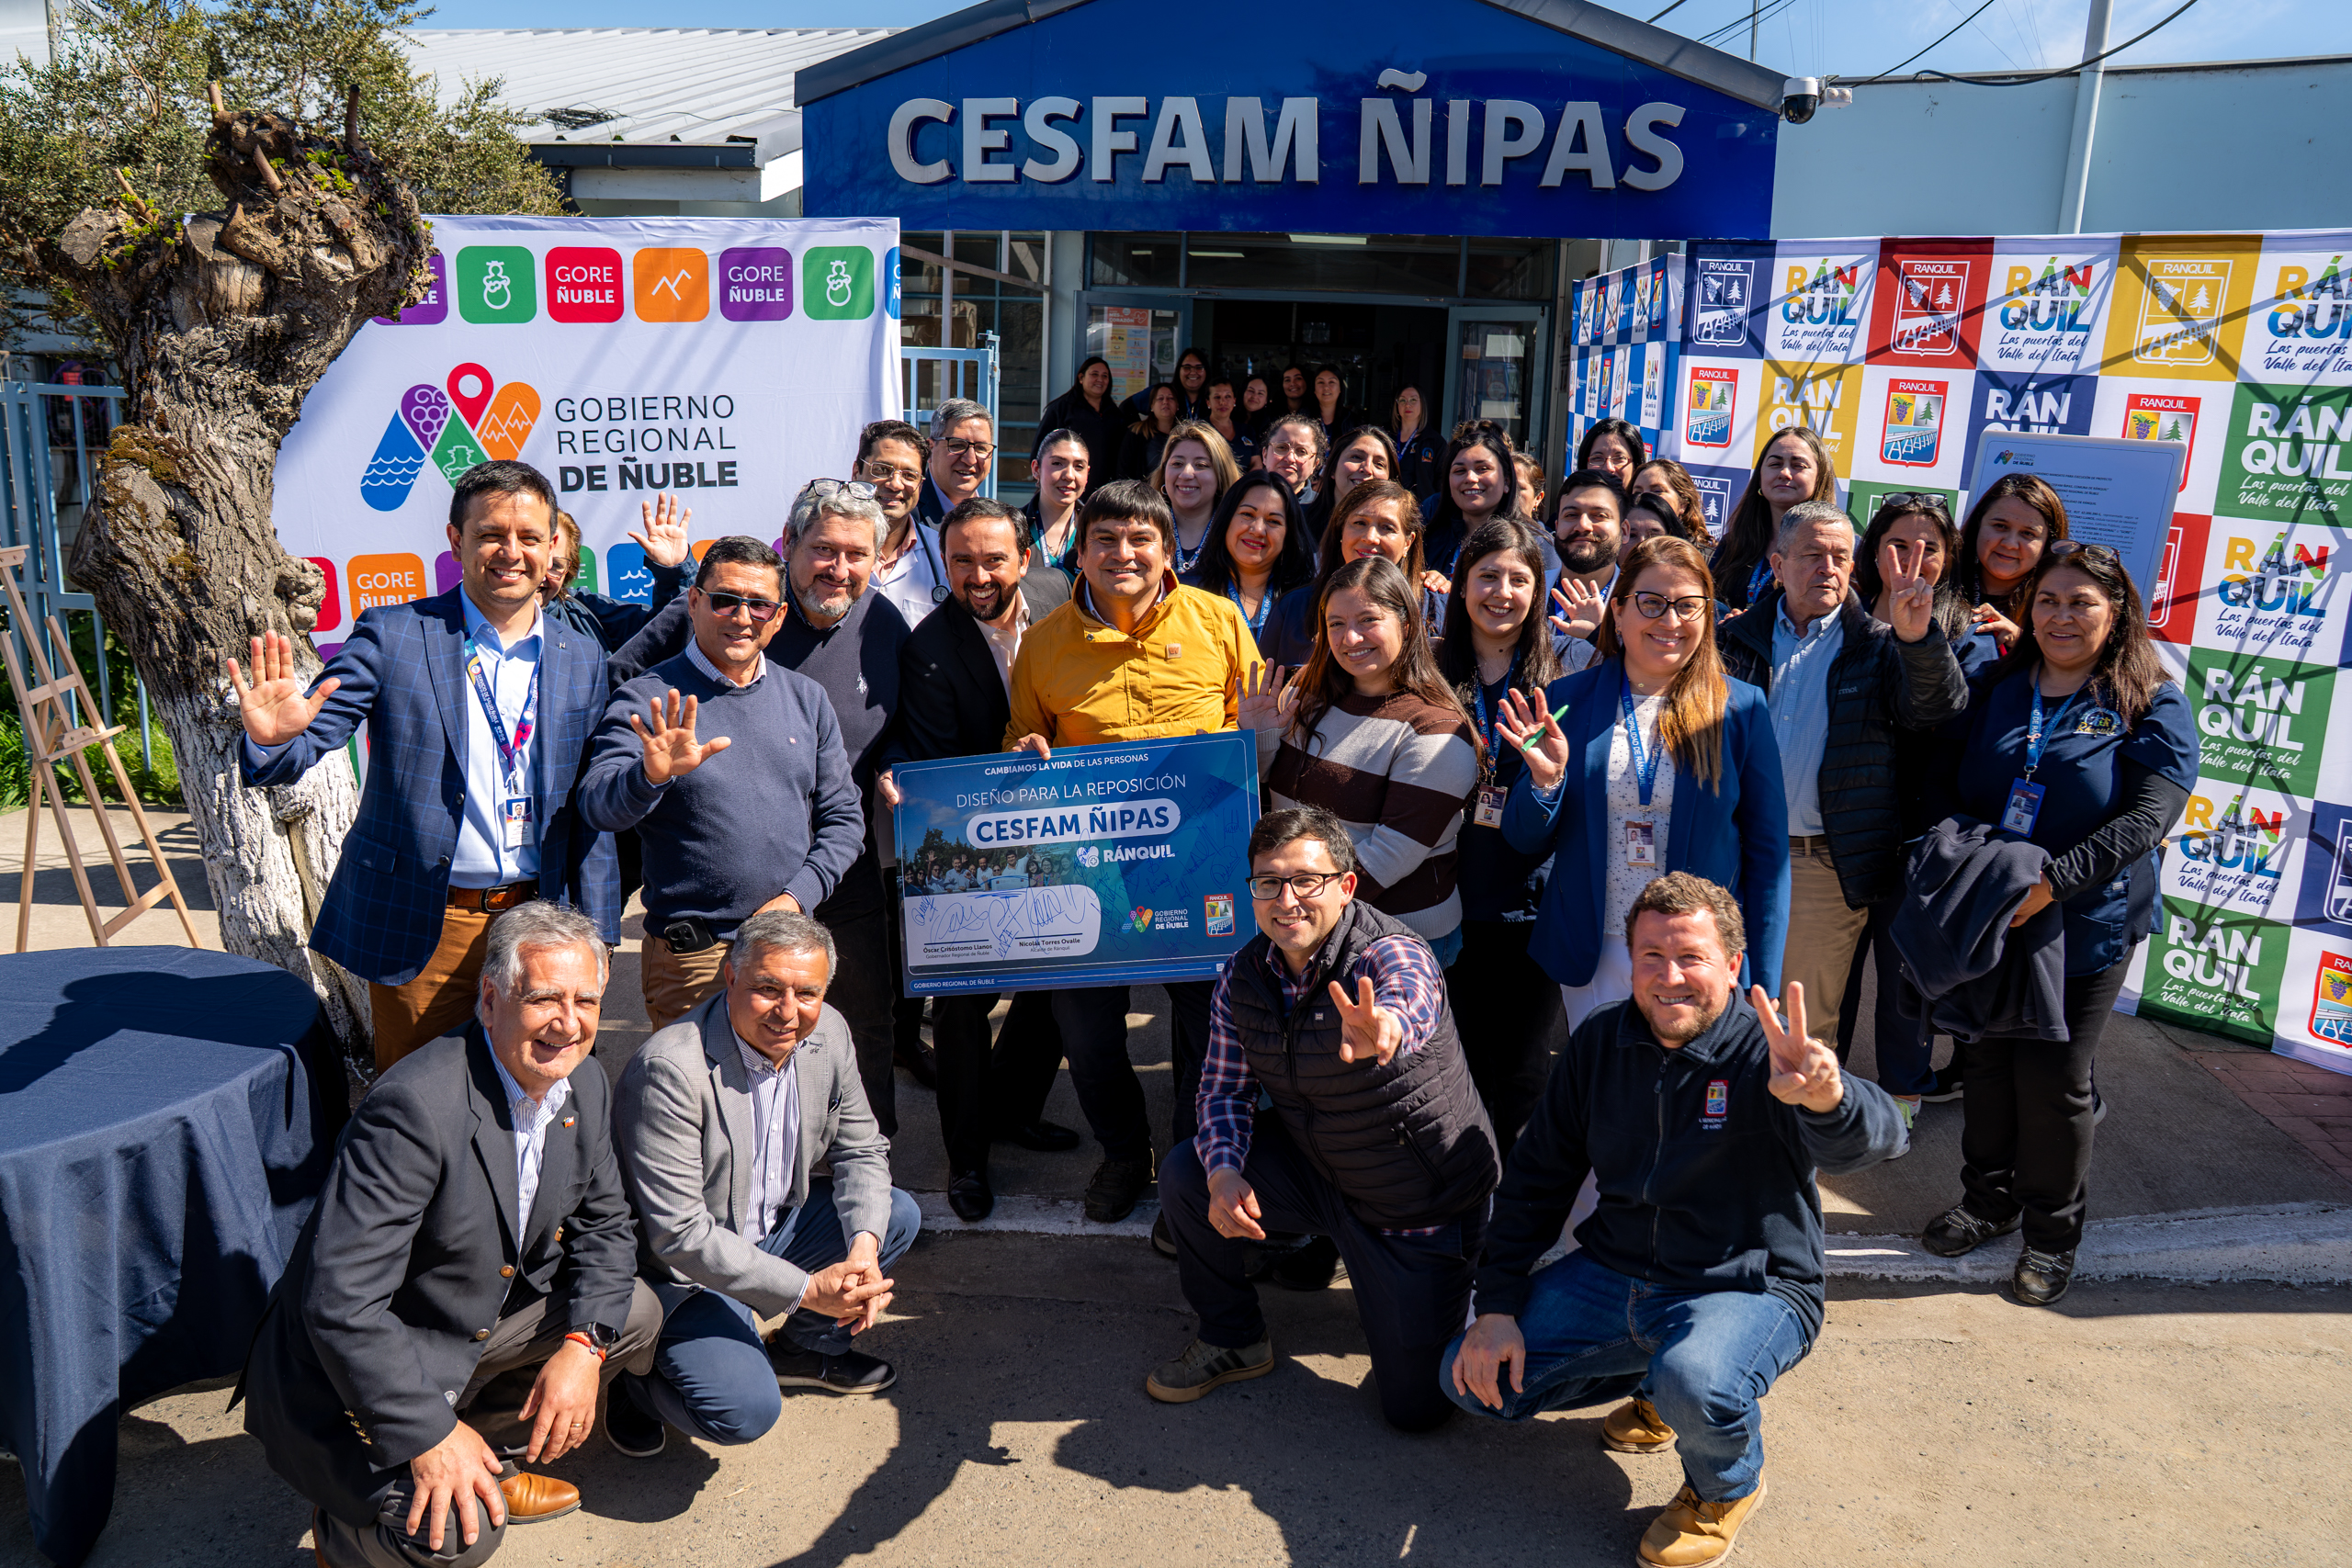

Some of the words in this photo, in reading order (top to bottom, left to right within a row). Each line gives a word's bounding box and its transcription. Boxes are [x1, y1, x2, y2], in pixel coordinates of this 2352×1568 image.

[888, 96, 1318, 184] CESFAM
[1359, 68, 1686, 191] ÑIPAS
[555, 265, 614, 283] GORE
[728, 265, 784, 283] GORE
[1709, 262, 1744, 272] RANQUIL
[1785, 258, 1859, 295] RÁN
[1914, 264, 1956, 274] RANQUIL
[2005, 256, 2093, 298] RÁN
[2163, 264, 2216, 275] RANQUIL
[2274, 255, 2352, 300] RÁ
[557, 286, 615, 305] ÑUBLE
[729, 285, 785, 303] ÑUBLE
[1782, 297, 1857, 325] QUIL
[1999, 299, 2091, 332] QUIL
[2267, 303, 2352, 339] QUI
[1781, 339, 1804, 352] Valle
[1805, 339, 1823, 352] del
[1825, 340, 1849, 353] Itata
[1782, 326, 1799, 339] Las
[1802, 329, 1838, 342] puertas
[1839, 325, 1855, 339] del
[1998, 332, 2022, 346] Las
[2023, 333, 2064, 348] puertas
[2067, 334, 2087, 348] del
[1997, 346, 2025, 361] Valle
[2027, 347, 2048, 362] del
[2051, 348, 2081, 363] Itata
[2266, 339, 2291, 355] Las
[2297, 343, 2348, 358] puertas
[1699, 369, 1730, 379] RANQUIL
[2263, 355, 2298, 372] Valle
[2301, 357, 2327, 373] del
[2331, 357, 2352, 373] Ita
[1772, 370, 1843, 409] RÁN
[1899, 381, 1938, 392] RANQUIL
[555, 394, 735, 423] GOBIERNO
[1985, 382, 2072, 424] RÁN
[2140, 398, 2188, 410] RANQUIL
[2246, 396, 2352, 442] RÁN
[557, 426, 736, 456] REGIONAL
[2241, 440, 2352, 480] QUIL
[560, 466, 606, 492] DE
[619, 457, 738, 491] ÑUBLE
[2239, 474, 2265, 491] Las
[2268, 479, 2320, 495] puertas
[2324, 480, 2348, 497] del
[2237, 491, 2270, 507] Valle
[2275, 493, 2299, 510] del
[2303, 496, 2340, 513] Itata
[2223, 532, 2329, 580] RÁN
[356, 571, 416, 590] GORE
[2218, 573, 2326, 618] QUIL
[2217, 608, 2242, 623] Las
[2245, 615, 2293, 631] puertas
[2299, 618, 2323, 635] del
[2215, 623, 2247, 639] Valle
[2252, 628, 2275, 645] del
[2279, 631, 2313, 649] Itata
[2202, 666, 2306, 715] RÁN
[1624, 701, 1639, 746] MUNICIPALIDAD
[2198, 704, 2304, 751] QUIL
[984, 763, 1037, 775] CAMBIAMOS
[1038, 761, 1050, 771] LA
[1050, 760, 1072, 770] VIDA
[1074, 759, 1085, 768] DE
[1087, 758, 1102, 767] LAS
[1104, 753, 1149, 764] PERSONAS
[1634, 747, 1641, 755] DE
[2199, 736, 2222, 751] Las
[2224, 746, 2272, 761] puertas
[2277, 752, 2301, 766] del
[2199, 751, 2227, 768] Valle
[2231, 760, 2255, 773] del
[2258, 762, 2292, 779] Itata
[1635, 756, 1645, 786] RÁNQUIL
[956, 787, 1014, 808] DISEÑO
[1019, 785, 1059, 802] PARA
[1064, 784, 1082, 798] LA
[1087, 773, 1186, 795] REPOSICIÓN
[976, 812, 1080, 843] CESFAM
[1089, 806, 1170, 835] ÑIPAS
[2184, 794, 2283, 844] RÁN
[1103, 844, 1175, 863] RÁNQUIL
[2179, 829, 2282, 879] QUIL
[2177, 875, 2209, 892] Valle
[2212, 883, 2234, 899] del
[2238, 888, 2271, 907] Itata
[2179, 861, 2203, 875] Las
[2205, 868, 2251, 887] puertas
[2256, 876, 2278, 894] del
[1155, 908, 1188, 917] GOBIERNO
[1155, 915, 1188, 923] REGIONAL
[940, 944, 973, 953] Crisóstomo
[2166, 915, 2262, 966] RÁN
[913, 981, 942, 989] GOBIERNO
[978, 977, 995, 986] ÑUBLE
[2163, 949, 2260, 1000] QUIL
[2160, 990, 2190, 1008] Valle
[2194, 998, 2215, 1016] del
[2220, 1005, 2251, 1024] Itata
[2162, 977, 2185, 992] Las
[2188, 986, 2233, 1005] puertas
[2236, 997, 2259, 1011] del
